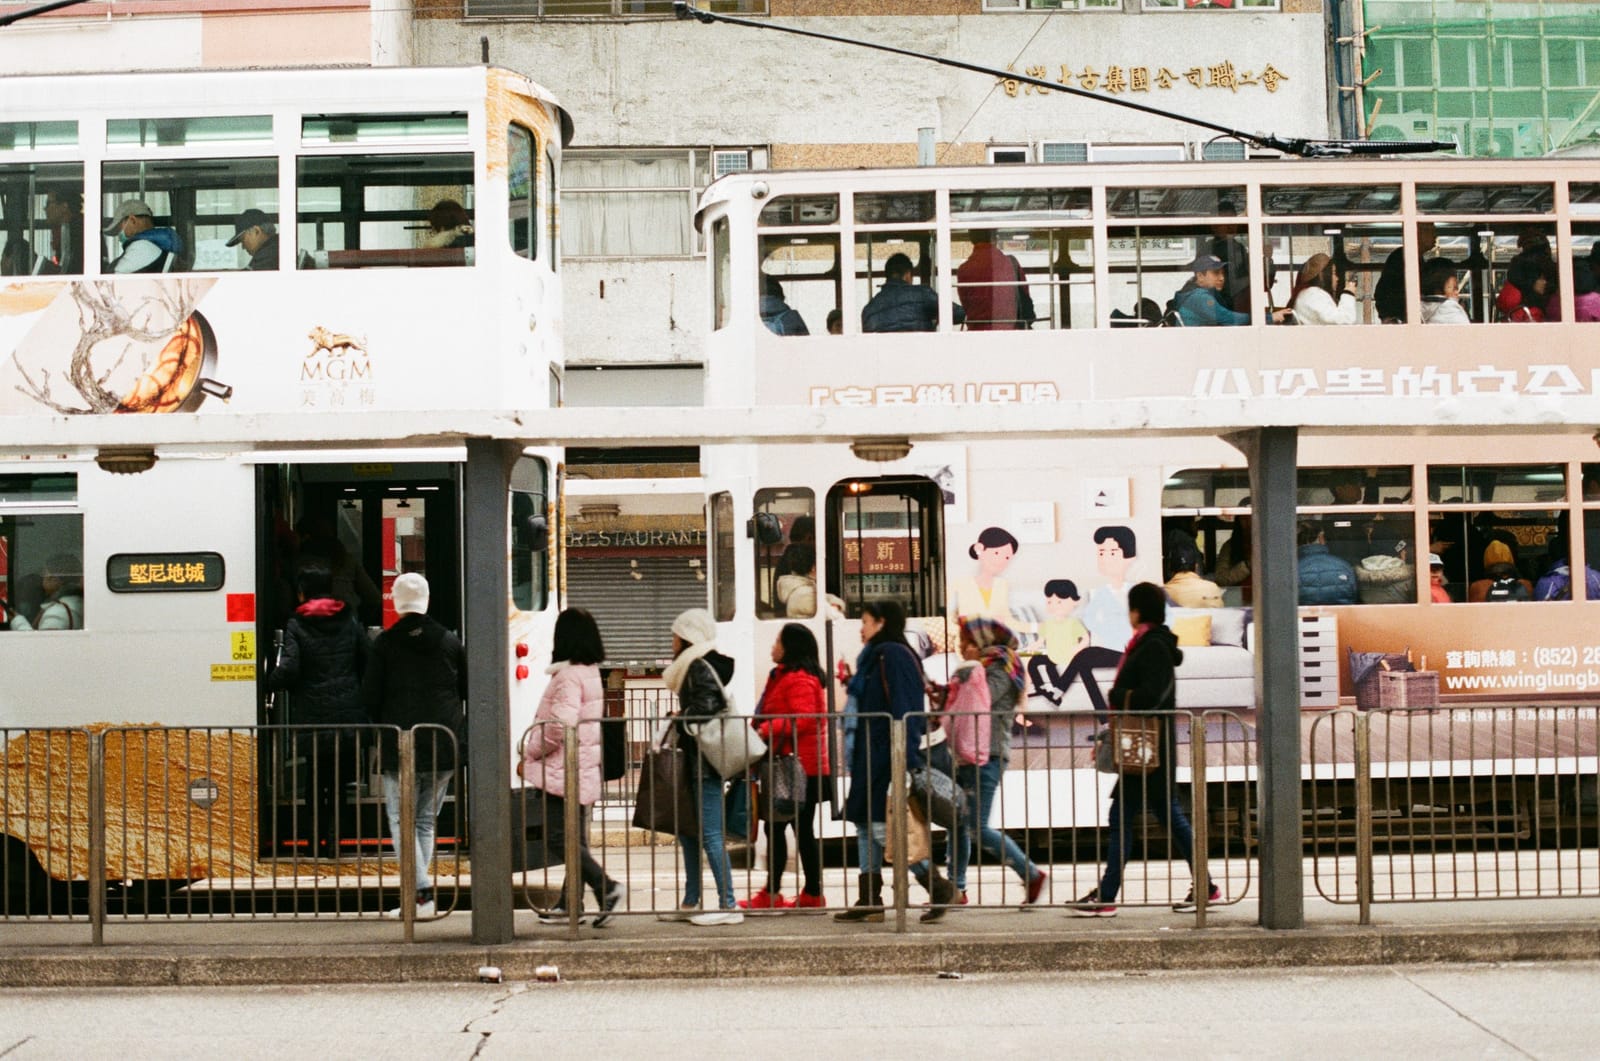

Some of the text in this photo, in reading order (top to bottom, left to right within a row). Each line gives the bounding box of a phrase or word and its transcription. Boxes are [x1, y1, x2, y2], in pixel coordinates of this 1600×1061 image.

[300, 359, 373, 381] MGM
[568, 529, 703, 547] RESTAURANT
[128, 562, 206, 584] 堅尼地城
[232, 652, 254, 660] ONLY
[1533, 646, 1578, 668] (852)
